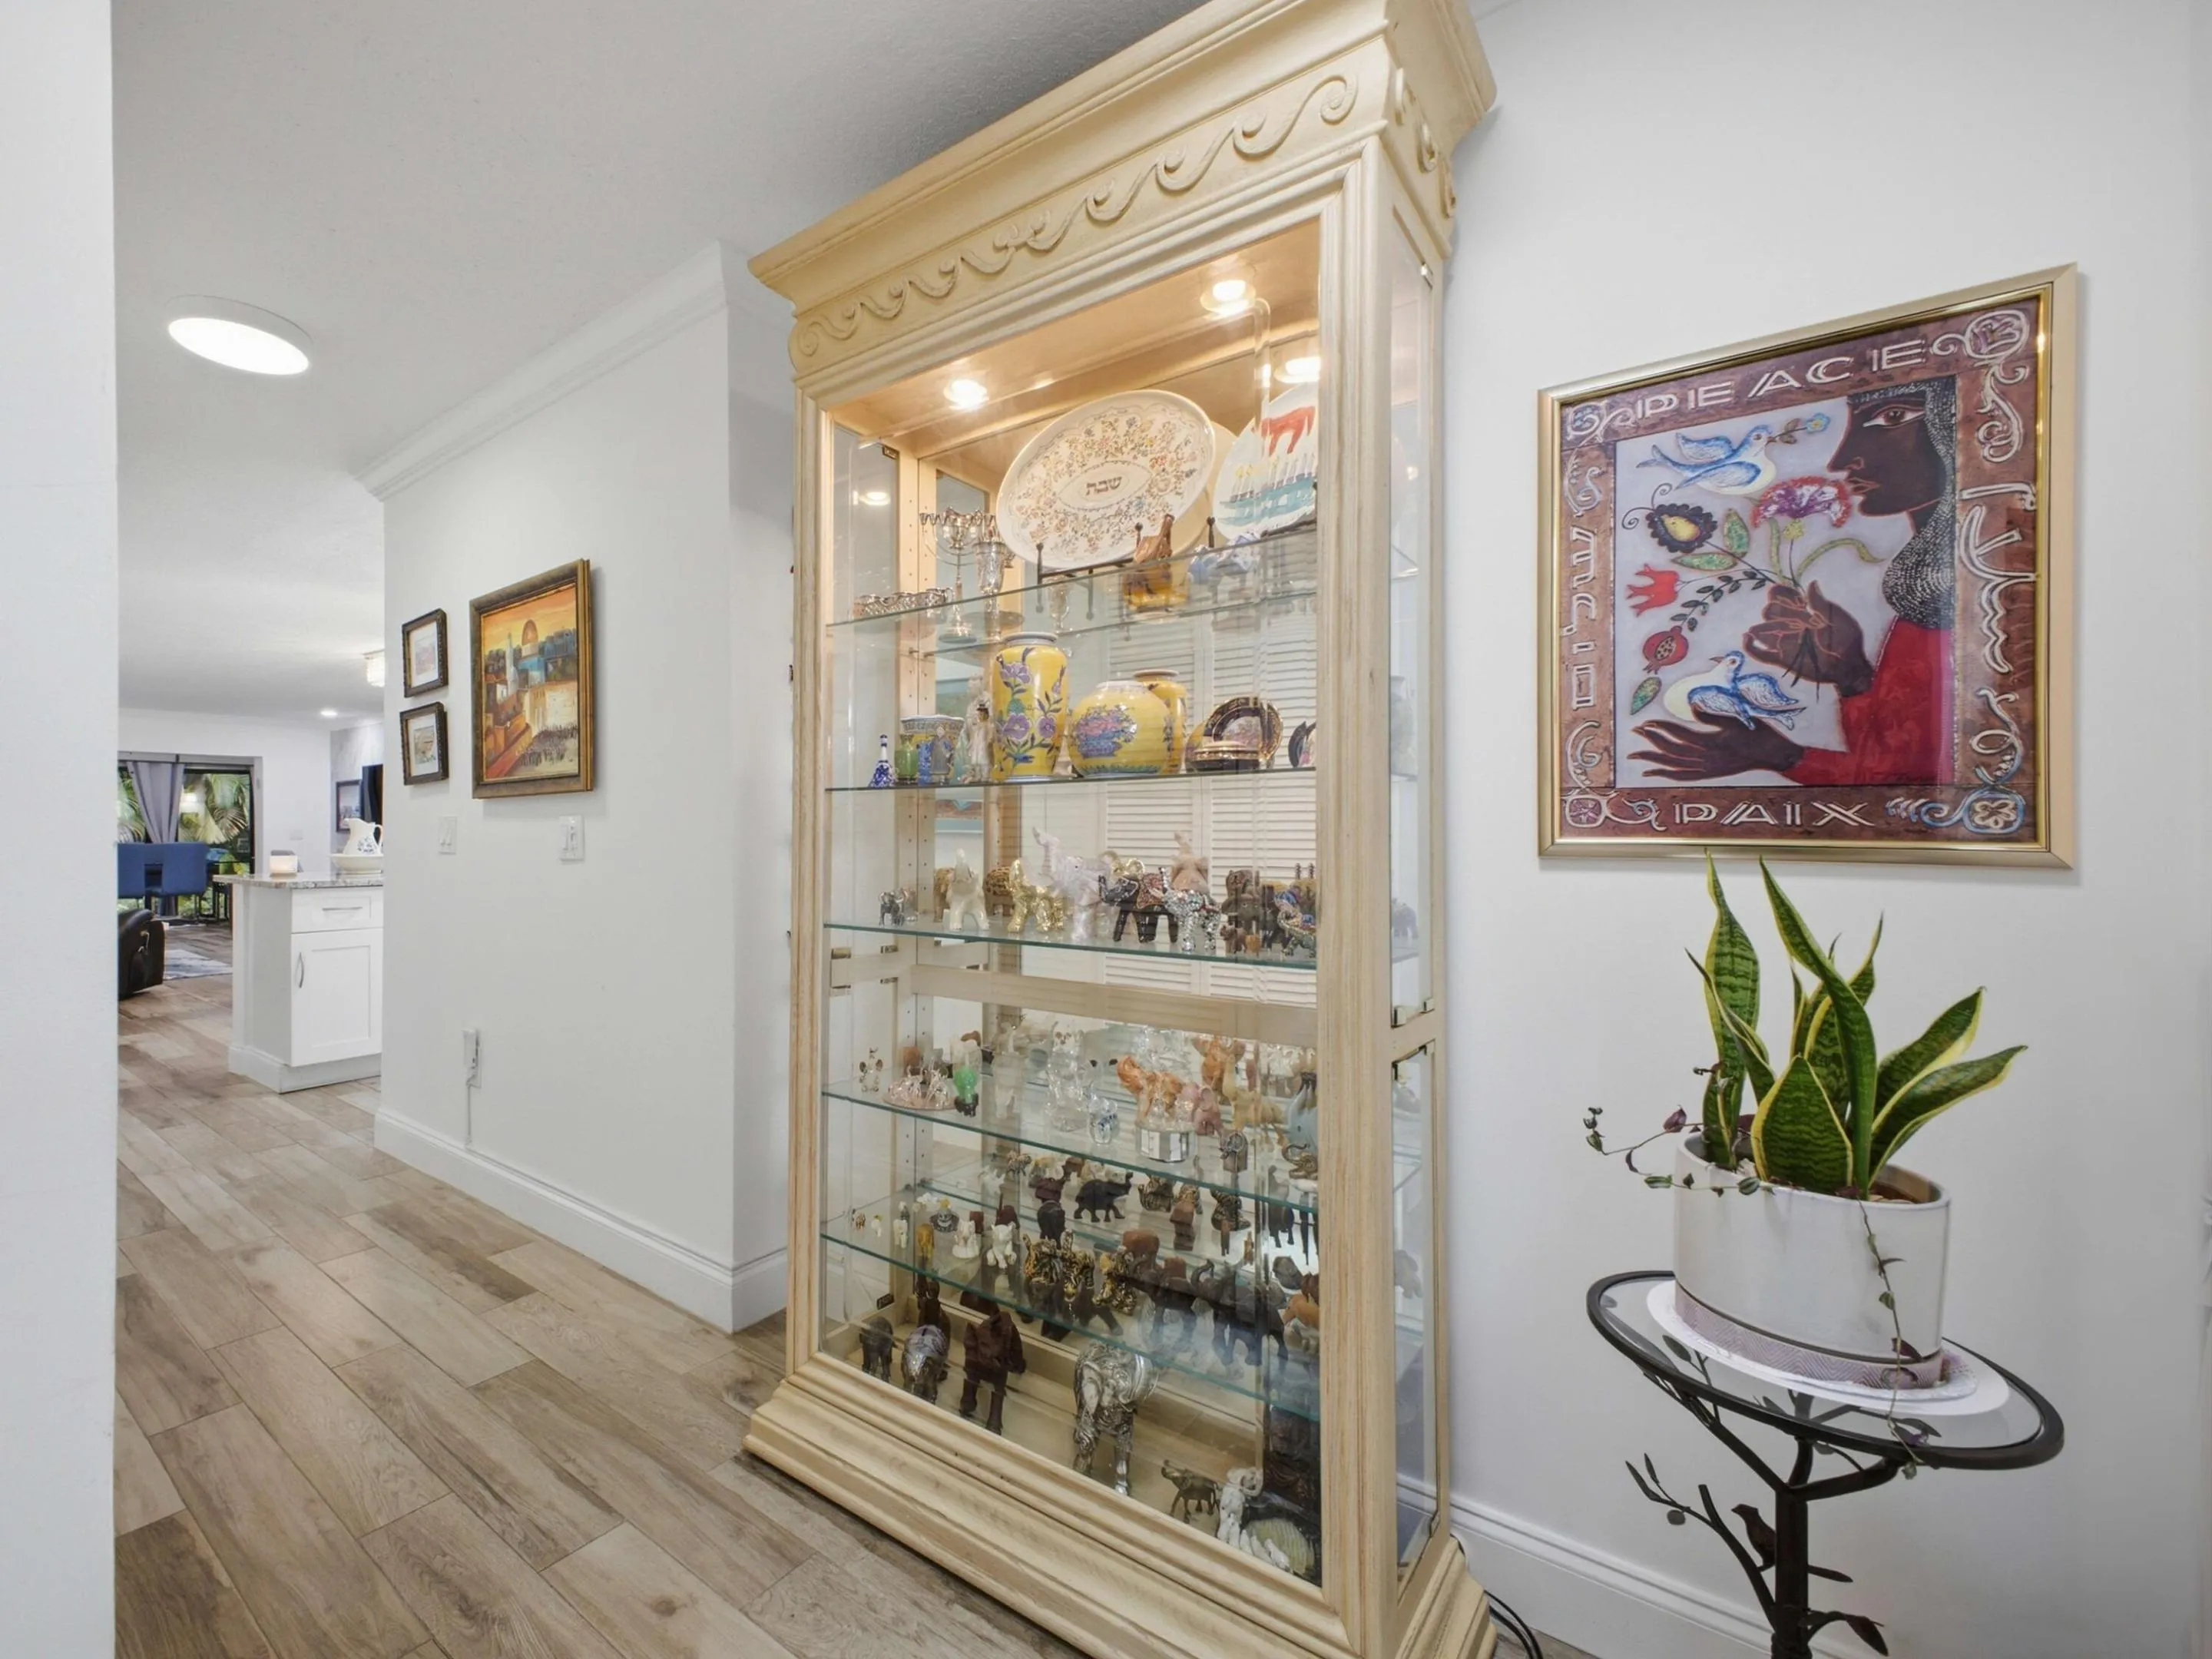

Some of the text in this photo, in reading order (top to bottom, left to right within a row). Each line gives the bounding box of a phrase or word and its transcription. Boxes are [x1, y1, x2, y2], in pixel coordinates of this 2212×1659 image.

[1637, 339, 1926, 419] PEACE
[1086, 476, 1122, 495] שבת
[1560, 524, 1598, 710] שלום
[1674, 801, 1876, 827] PAIX
